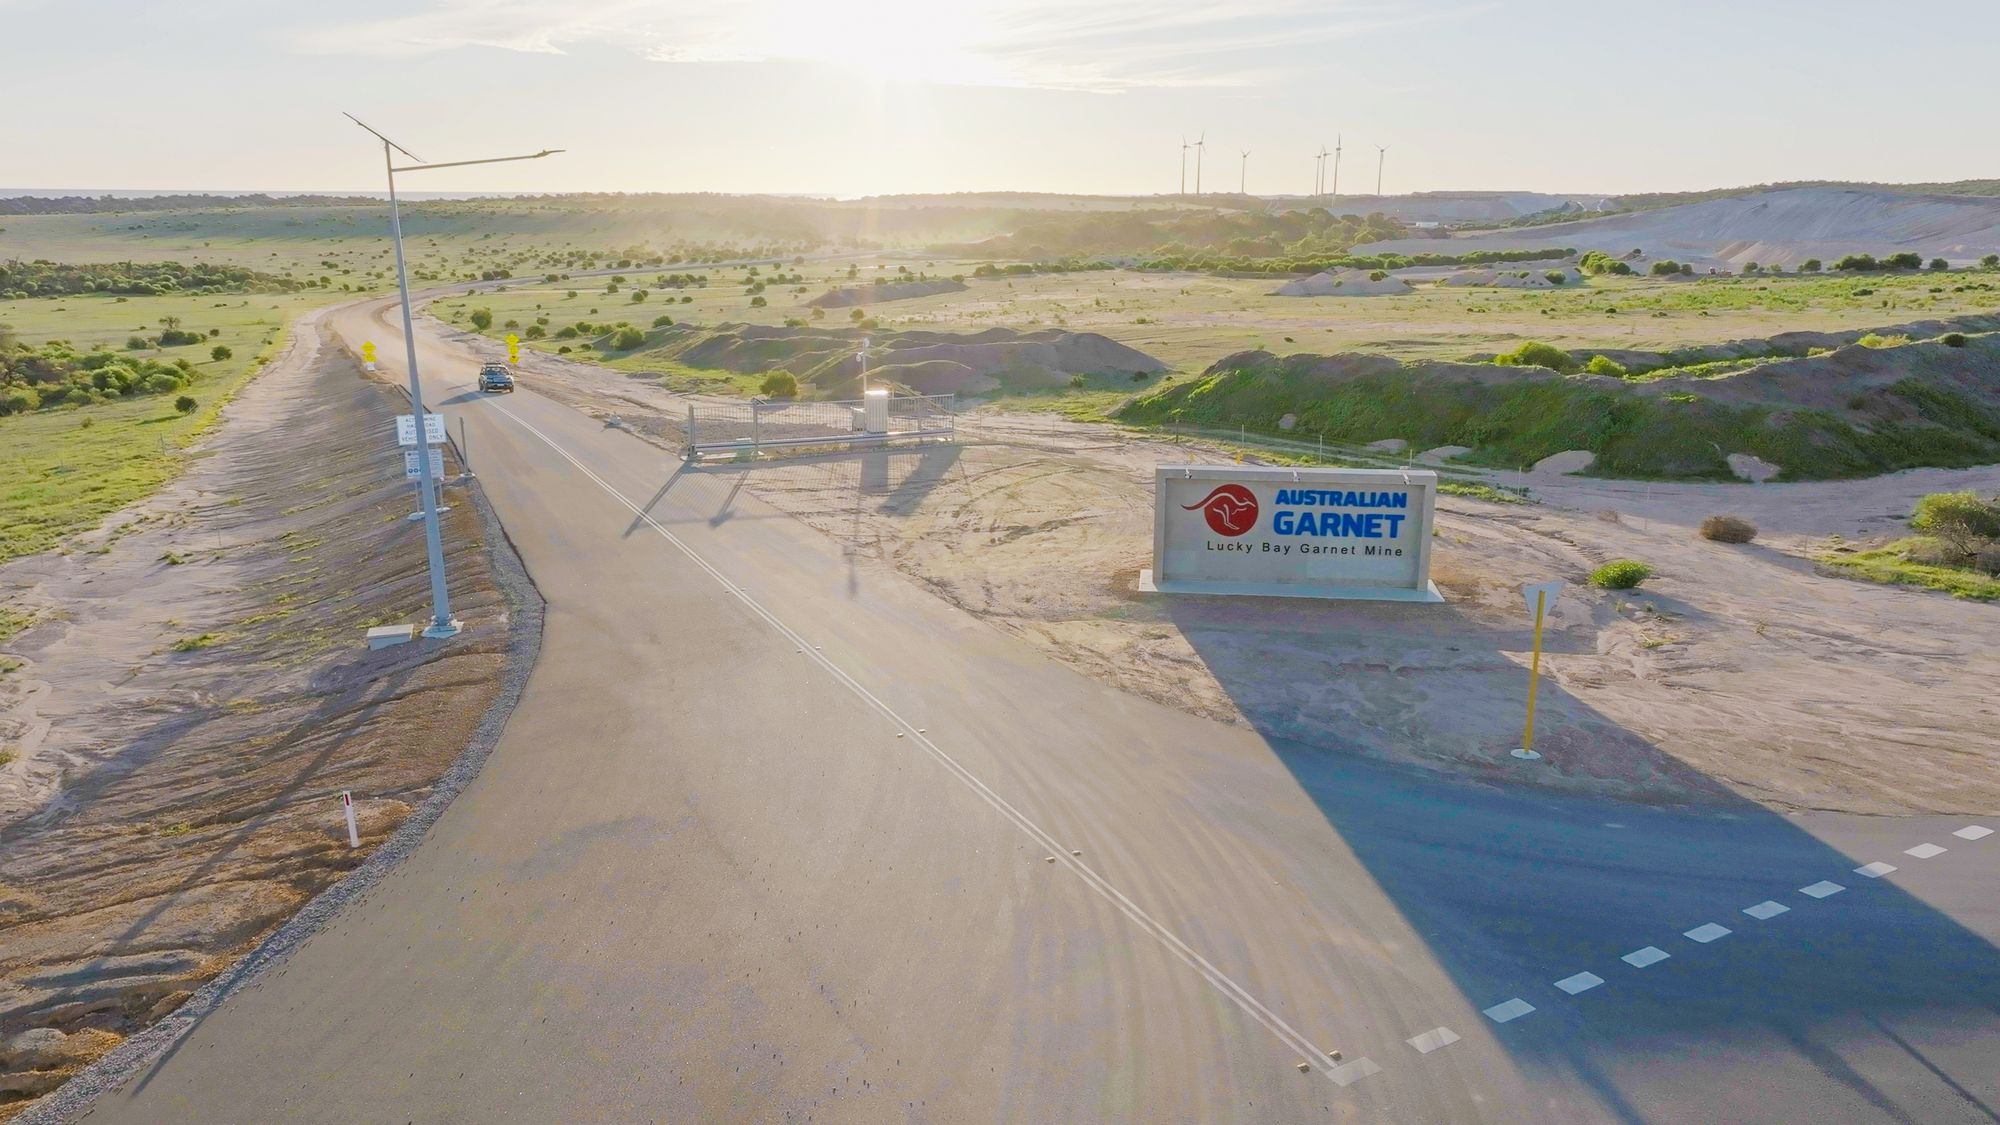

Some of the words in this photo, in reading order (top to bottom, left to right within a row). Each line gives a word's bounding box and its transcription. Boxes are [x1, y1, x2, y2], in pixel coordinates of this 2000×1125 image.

[1275, 489, 1408, 508] AUSTRALIAN
[1273, 511, 1405, 538] GARNET
[1207, 541, 1253, 555] Lucky
[1262, 542, 1291, 556] Bay
[1300, 543, 1356, 556] Garnet
[1365, 546, 1403, 557] Mine
